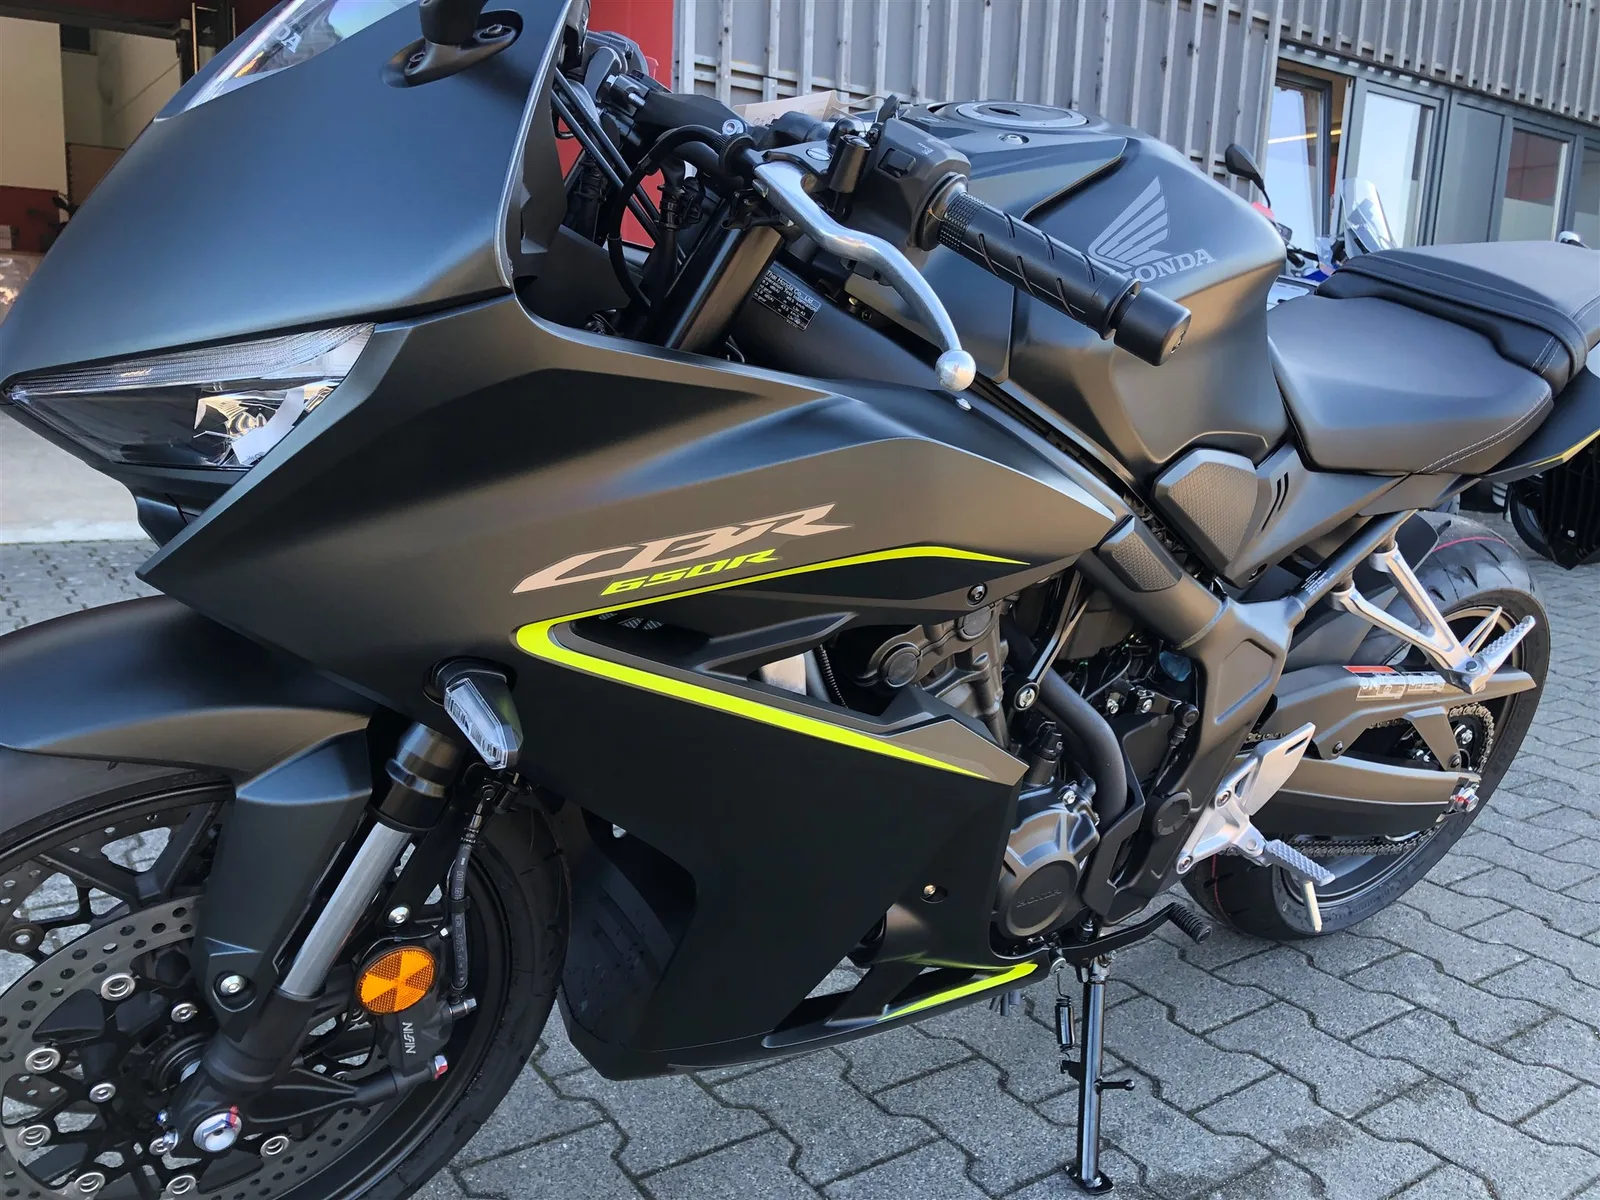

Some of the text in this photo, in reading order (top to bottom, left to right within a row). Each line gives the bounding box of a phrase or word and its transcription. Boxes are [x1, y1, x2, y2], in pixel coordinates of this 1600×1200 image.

[777, 277, 794, 291] Honda
[512, 502, 853, 594] CBR
[600, 548, 780, 596] 650R
